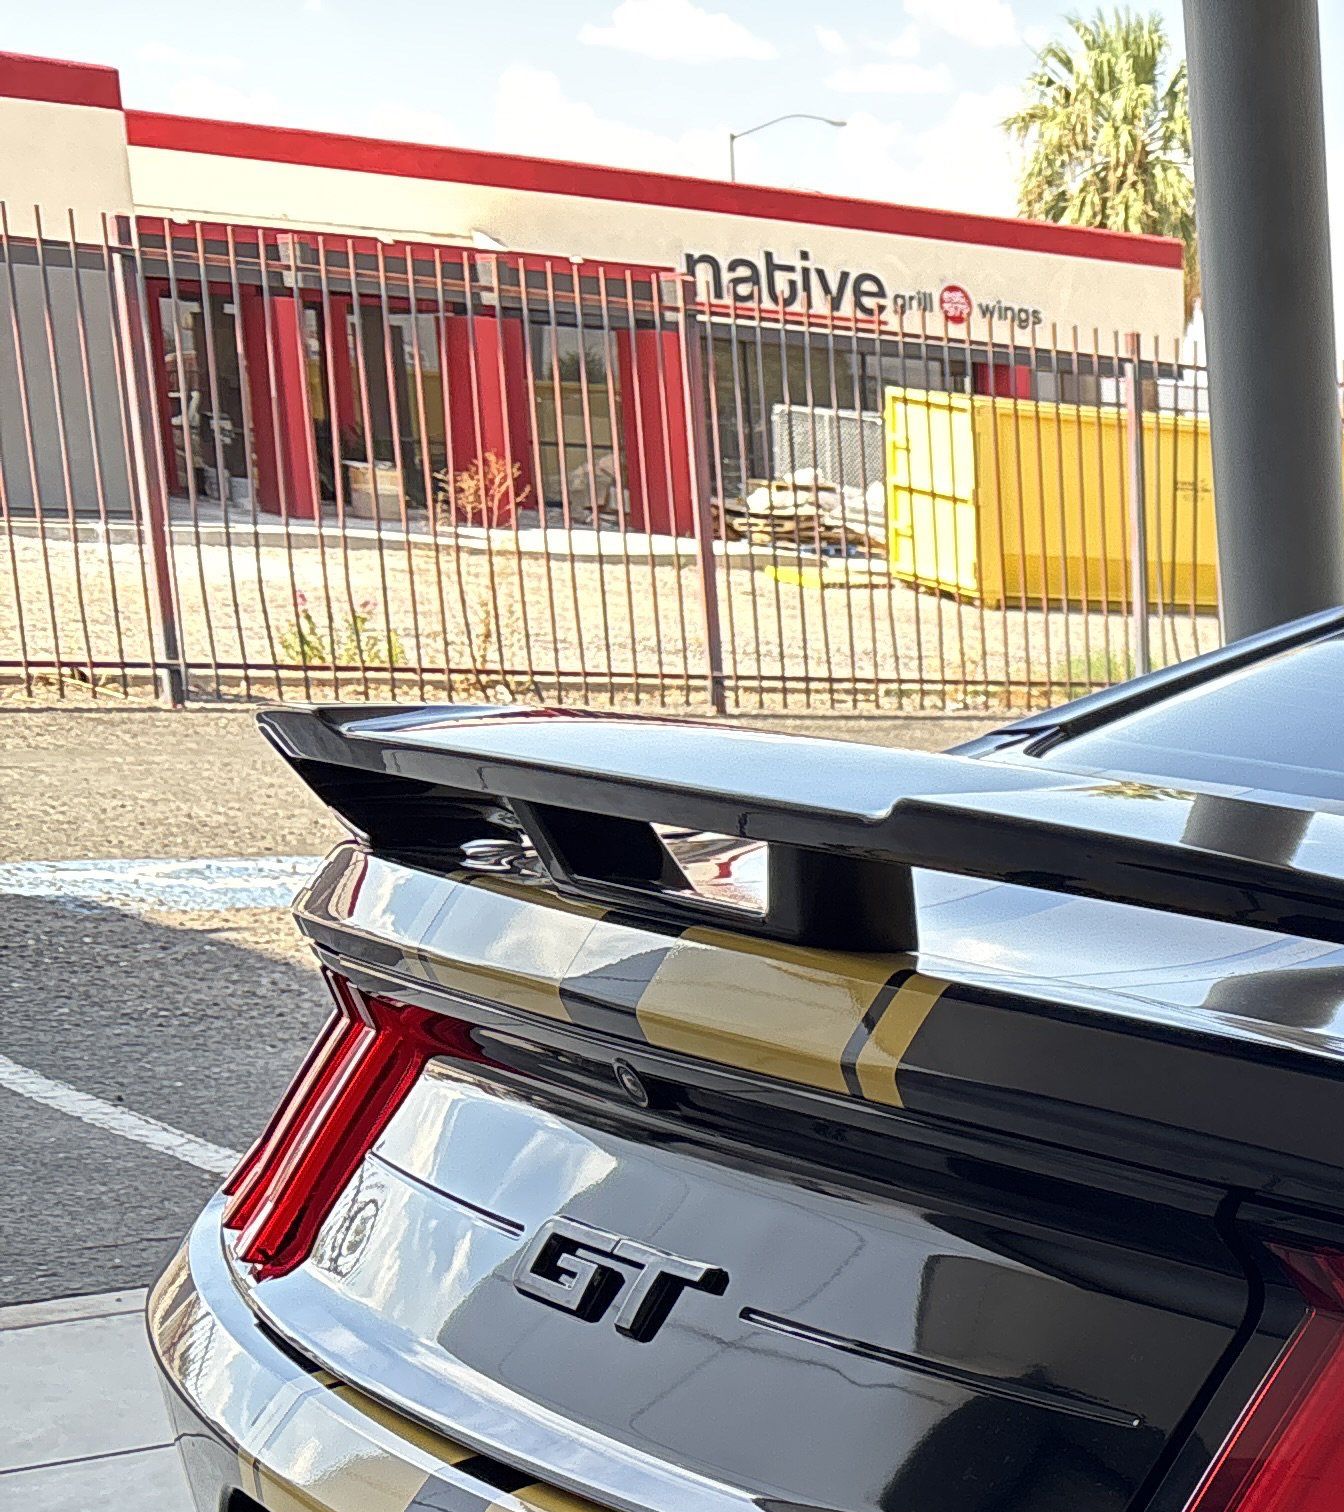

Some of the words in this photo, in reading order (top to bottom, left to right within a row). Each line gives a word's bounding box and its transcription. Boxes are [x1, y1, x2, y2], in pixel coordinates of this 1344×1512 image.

[685, 250, 887, 317] native
[893, 290, 934, 317] grill
[977, 299, 1043, 330] wings
[513, 1213, 730, 1343] GT
